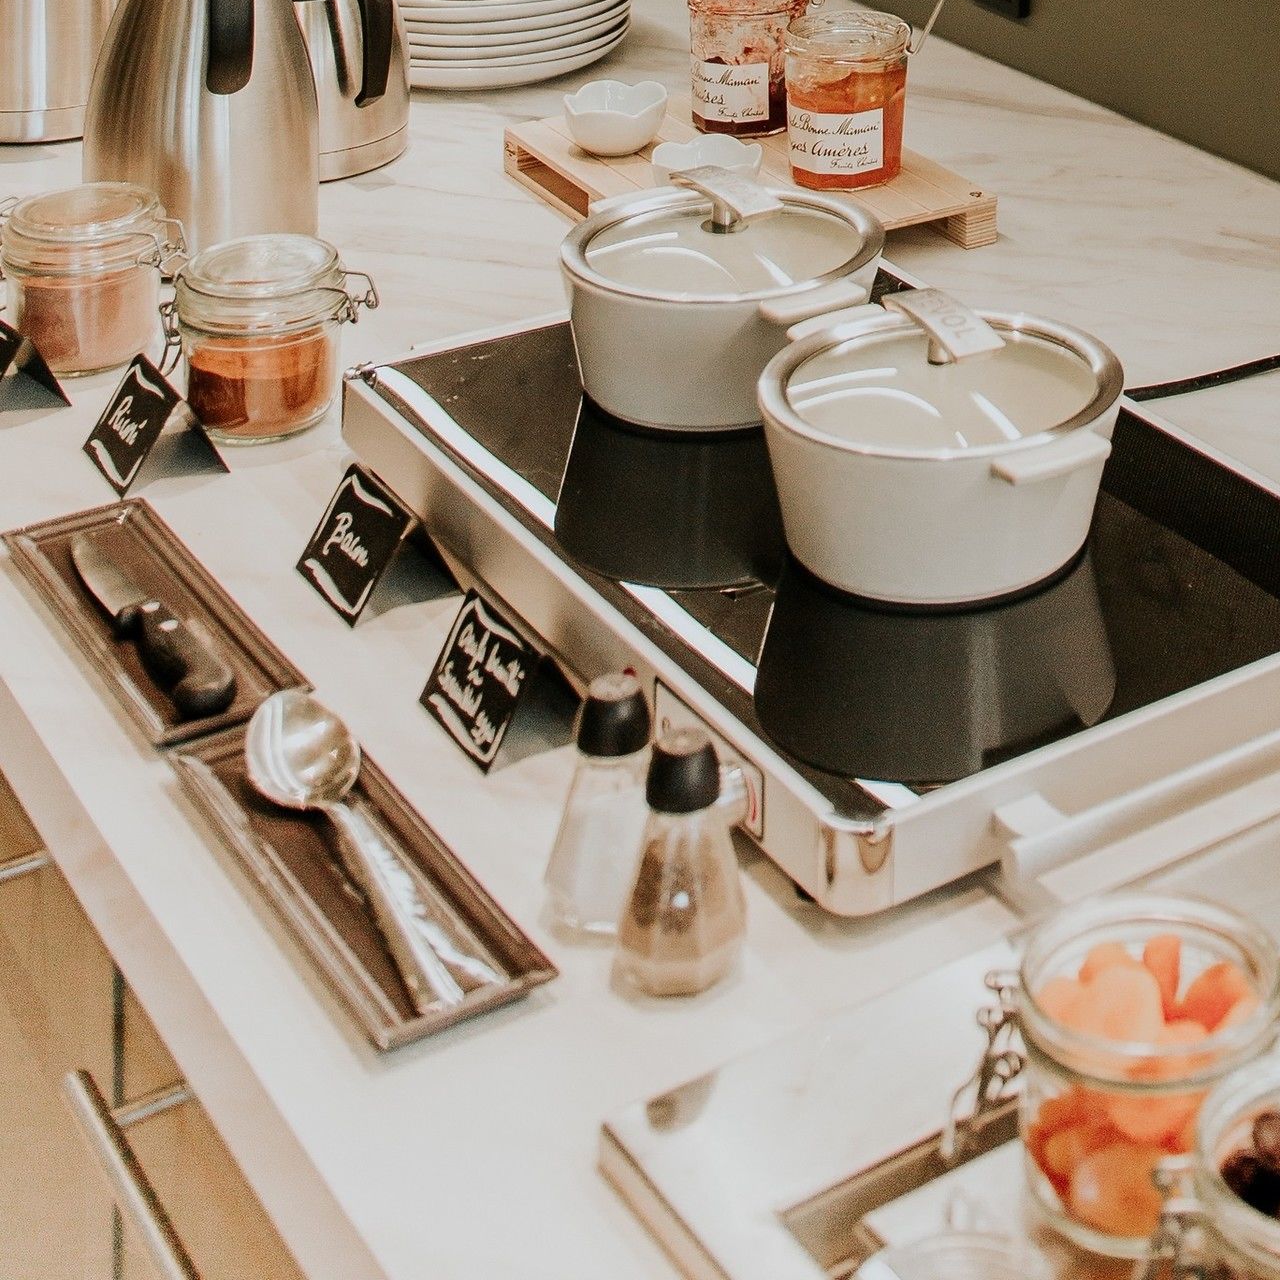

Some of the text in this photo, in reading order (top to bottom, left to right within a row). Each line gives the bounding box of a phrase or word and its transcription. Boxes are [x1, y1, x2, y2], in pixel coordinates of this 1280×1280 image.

[716, 70, 760, 86] Maman
[832, 118, 879, 135] Maman
[812, 140, 869, 157] Amères
